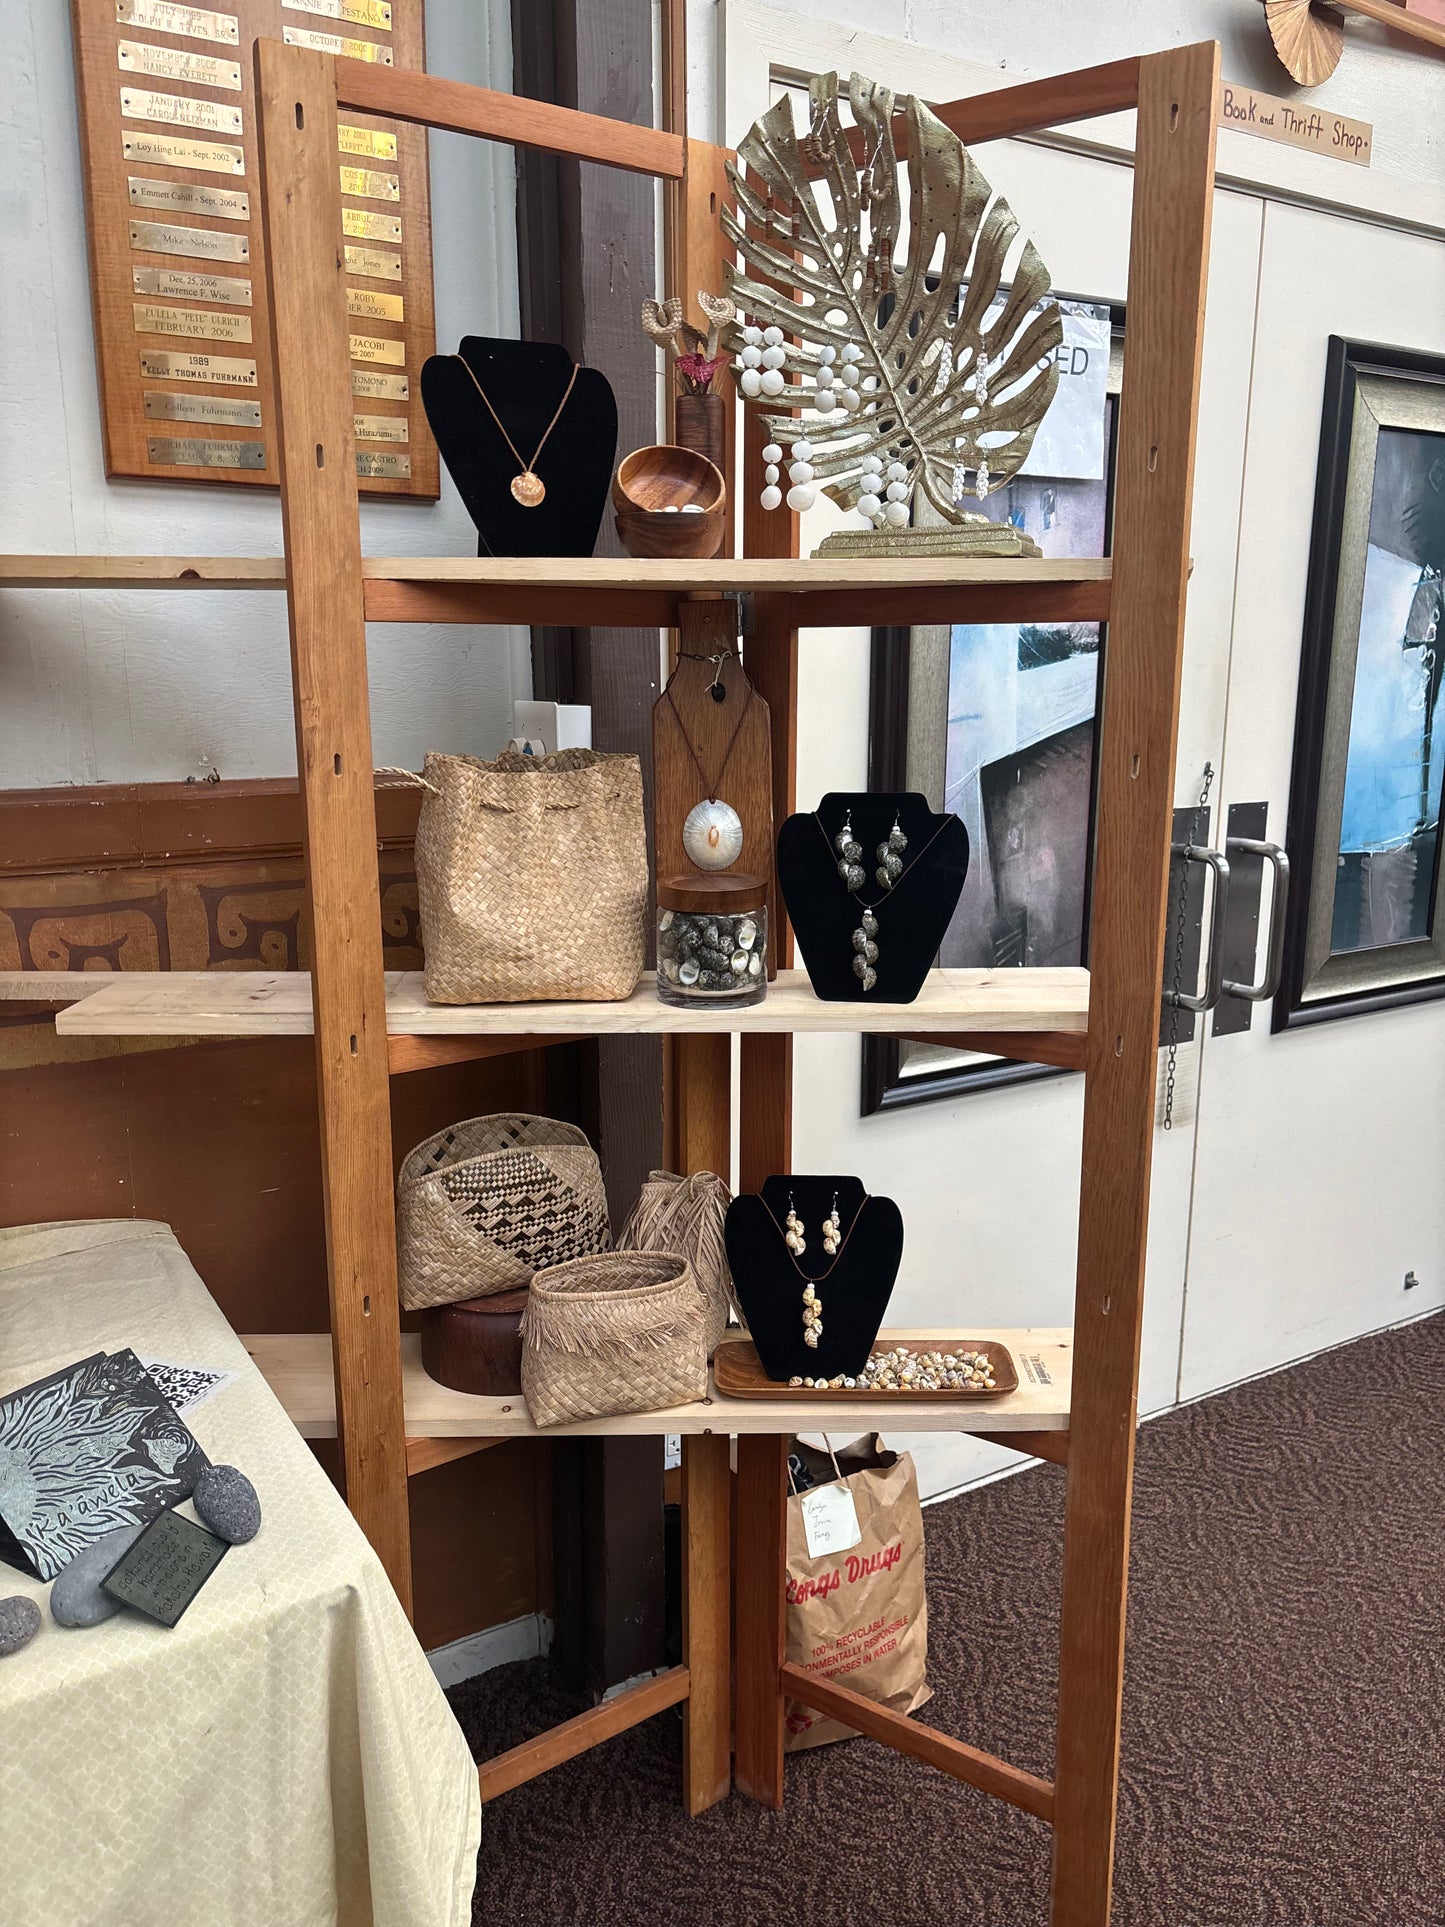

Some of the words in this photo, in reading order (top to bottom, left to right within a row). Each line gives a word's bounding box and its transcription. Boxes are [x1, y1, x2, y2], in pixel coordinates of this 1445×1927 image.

[153, 3, 177, 17] JULY
[342, 6, 381, 23] PESTANO
[309, 33, 345, 49] OCTOBER
[143, 62, 174, 75] NANCY
[180, 68, 218, 83] EVERETT
[149, 95, 191, 111] JANUARY
[196, 103, 216, 115] 2001
[1223, 89, 1257, 122] Book
[1260, 113, 1274, 125] and
[1281, 107, 1324, 139] Thrift
[136, 141, 152, 153] Loy
[153, 144, 172, 156] Hing
[174, 146, 186, 156] Lai
[192, 149, 211, 161] Sept.
[212, 152, 231, 163] 2002
[141, 187, 170, 199] Emmett
[171, 191, 193, 203] Cahill
[200, 195, 217, 207] Sept.
[219, 198, 237, 208] 2004
[162, 233, 184, 245] Mike
[191, 238, 218, 250] Nelson
[363, 257, 381, 268] Jones
[169, 274, 185, 285] Dec.
[186, 276, 198, 286] 25,
[199, 278, 218, 288] 2006
[157, 283, 198, 297] Lawrence
[200, 288, 208, 298] F.
[209, 290, 231, 301] Wise
[354, 292, 376, 303] ROBY
[366, 305, 386, 316] 2005
[211, 315, 240, 327] ULRICH
[155, 321, 206, 335] FEBRUARY
[211, 327, 234, 338] 2006
[353, 338, 385, 351] JACOBI
[189, 356, 210, 366] 1989
[359, 350, 375, 359] 2007
[146, 365, 171, 376] KELLY
[175, 368, 207, 379] THOMAS
[211, 372, 254, 384] FUHRMANN
[352, 375, 388, 386] TOMONO
[165, 401, 195, 413] Colleen
[201, 405, 242, 417] Fuhrmann
[359, 428, 393, 438] Hirazumi
[159, 439, 197, 452] MICHAEL
[203, 441, 246, 454] FUHRMA
[365, 455, 397, 465] CASTRO
[367, 466, 384, 474] 2009
[786, 1569, 841, 1605] Longs
[844, 1543, 902, 1583] Drugs
[811, 1641, 834, 1658] 100%
[836, 1616, 886, 1649] RECYCLABLE
[864, 1615, 909, 1650] RESPONSIBLE
[863, 1653, 872, 1665] IN
[873, 1638, 898, 1660] WATER
